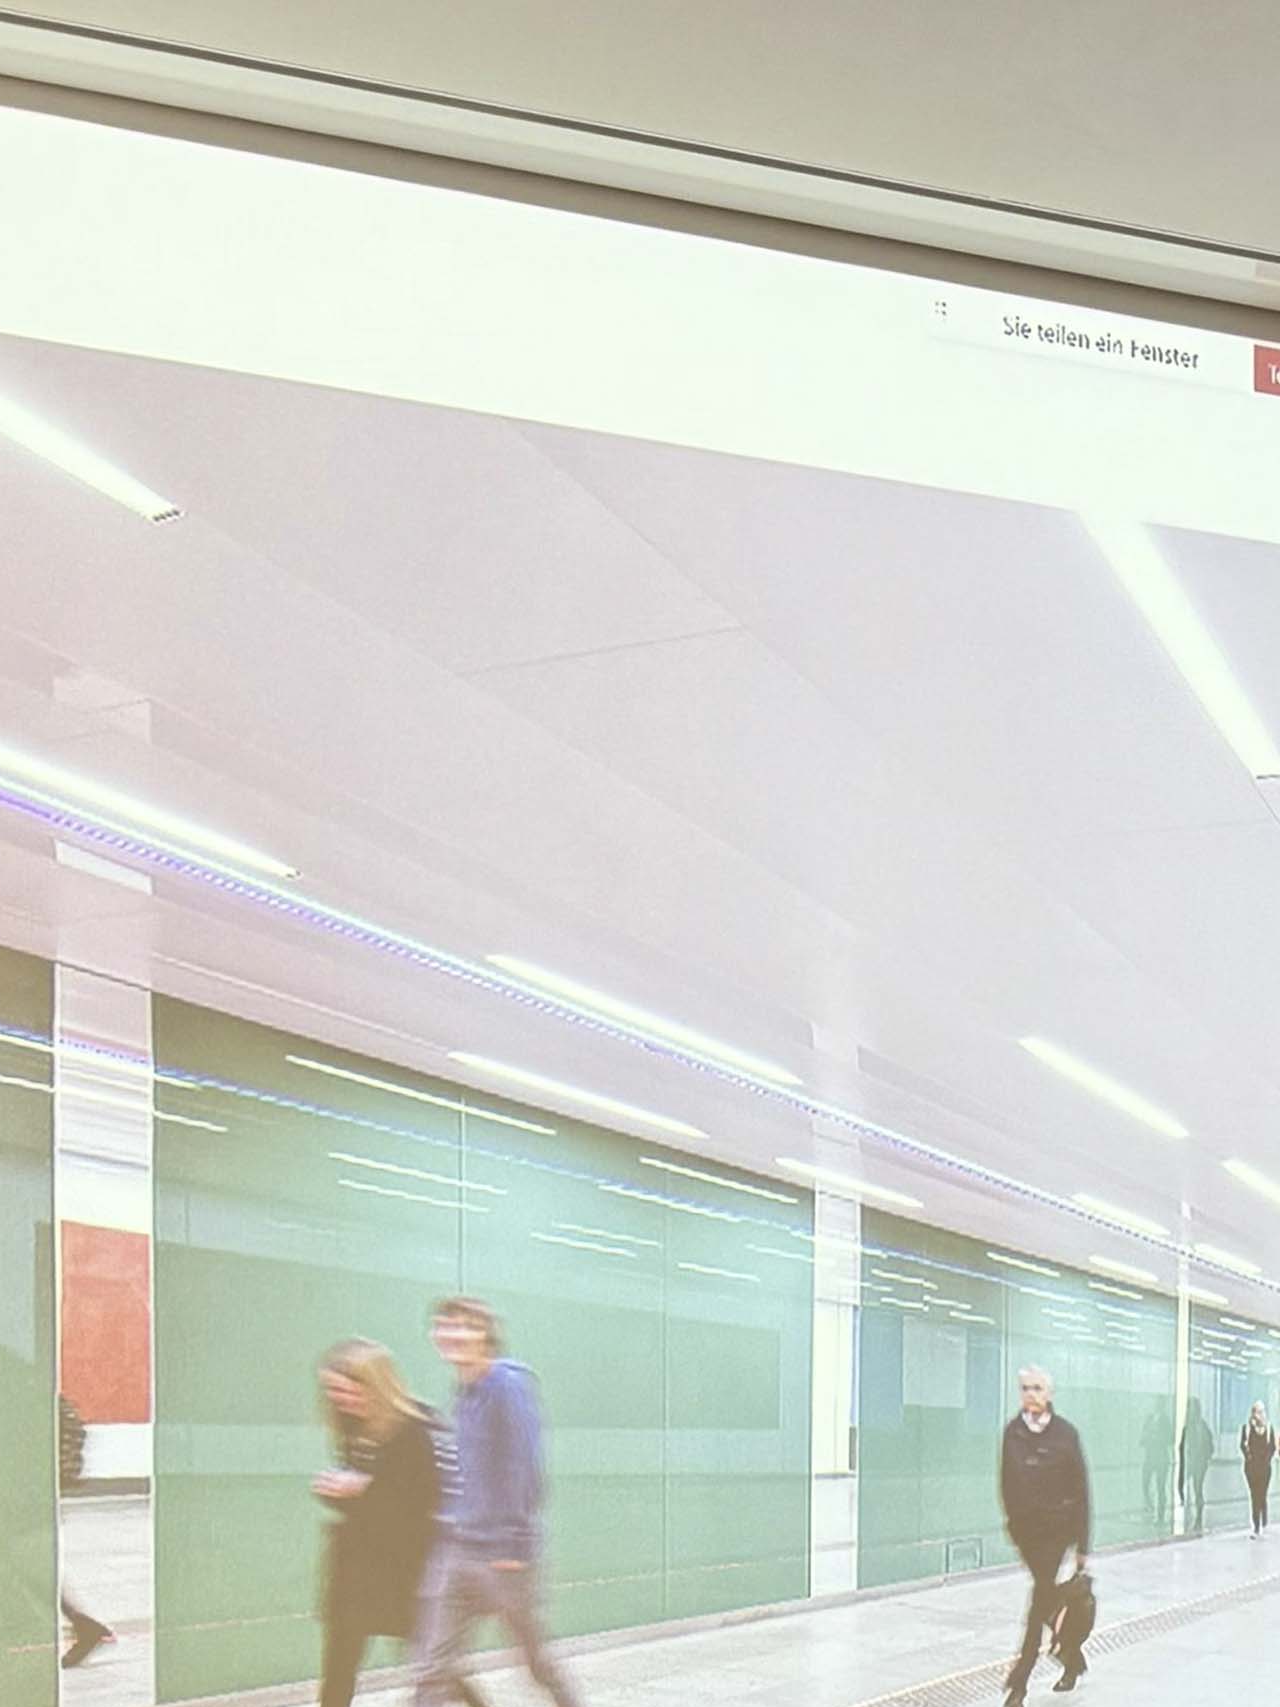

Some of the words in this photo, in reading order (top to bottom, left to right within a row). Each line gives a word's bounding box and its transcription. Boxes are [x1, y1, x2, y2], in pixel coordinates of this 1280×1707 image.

[1003, 315, 1032, 339] Sie
[1037, 323, 1090, 350] teilen
[1095, 332, 1123, 354] ein
[1130, 340, 1199, 368] Fenster
